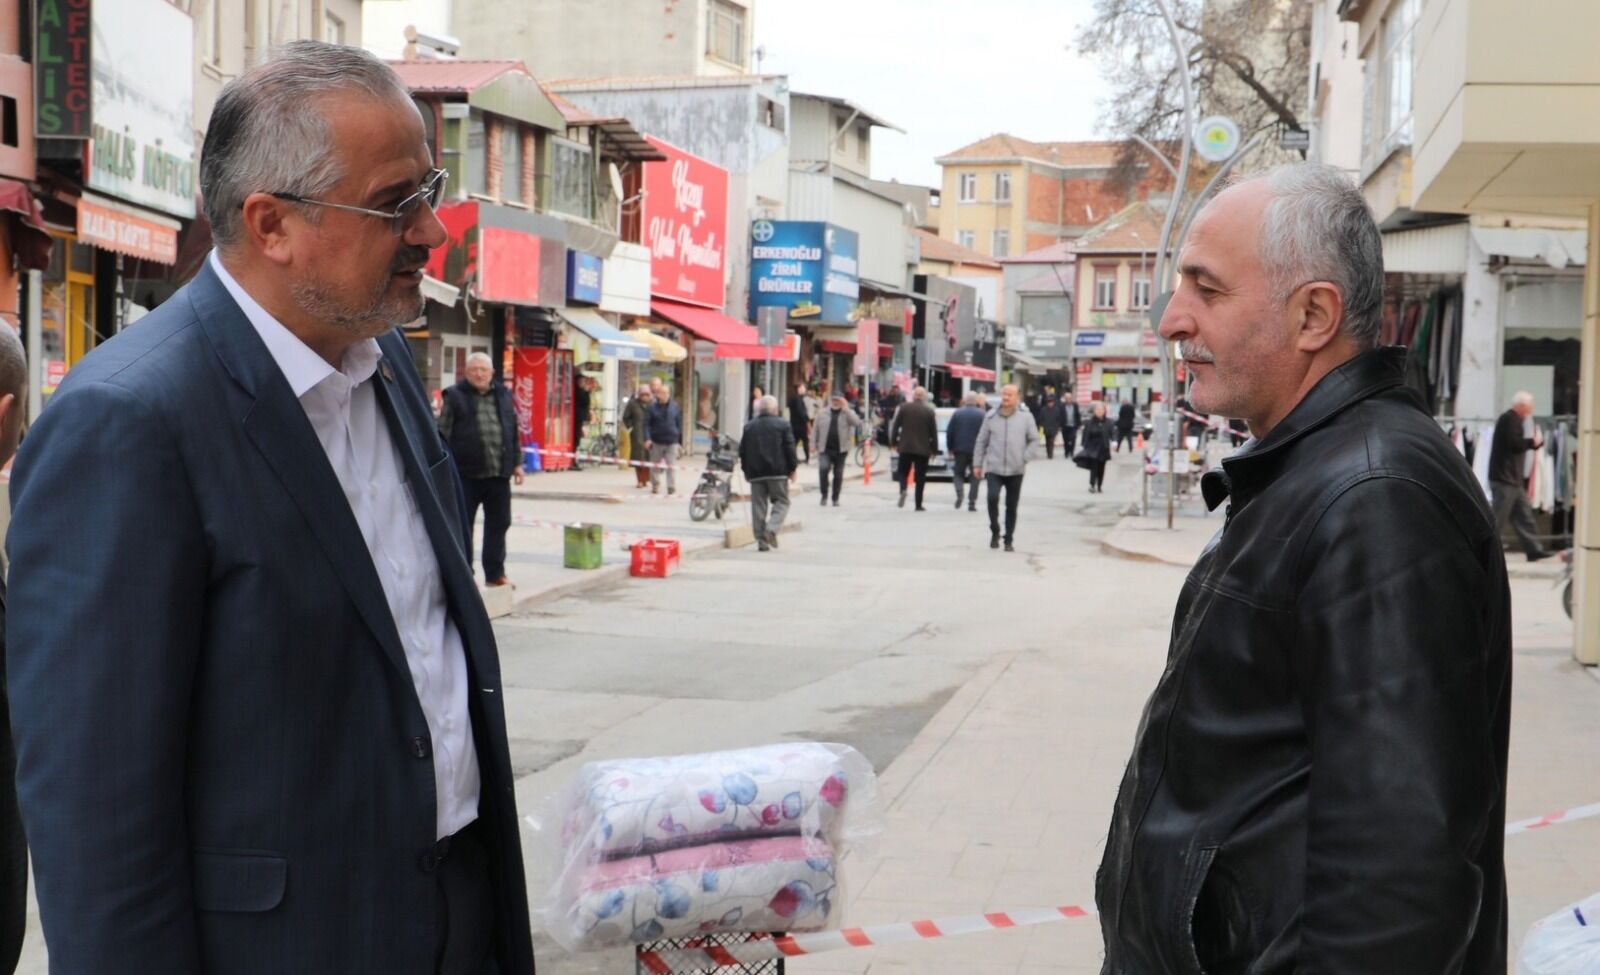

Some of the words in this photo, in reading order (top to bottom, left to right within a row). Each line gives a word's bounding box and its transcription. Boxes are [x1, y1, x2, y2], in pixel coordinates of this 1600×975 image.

[92, 124, 135, 181] HALİS
[753, 245, 821, 260] ERKENOĞLU
[758, 277, 813, 293] ÜRÜNLER
